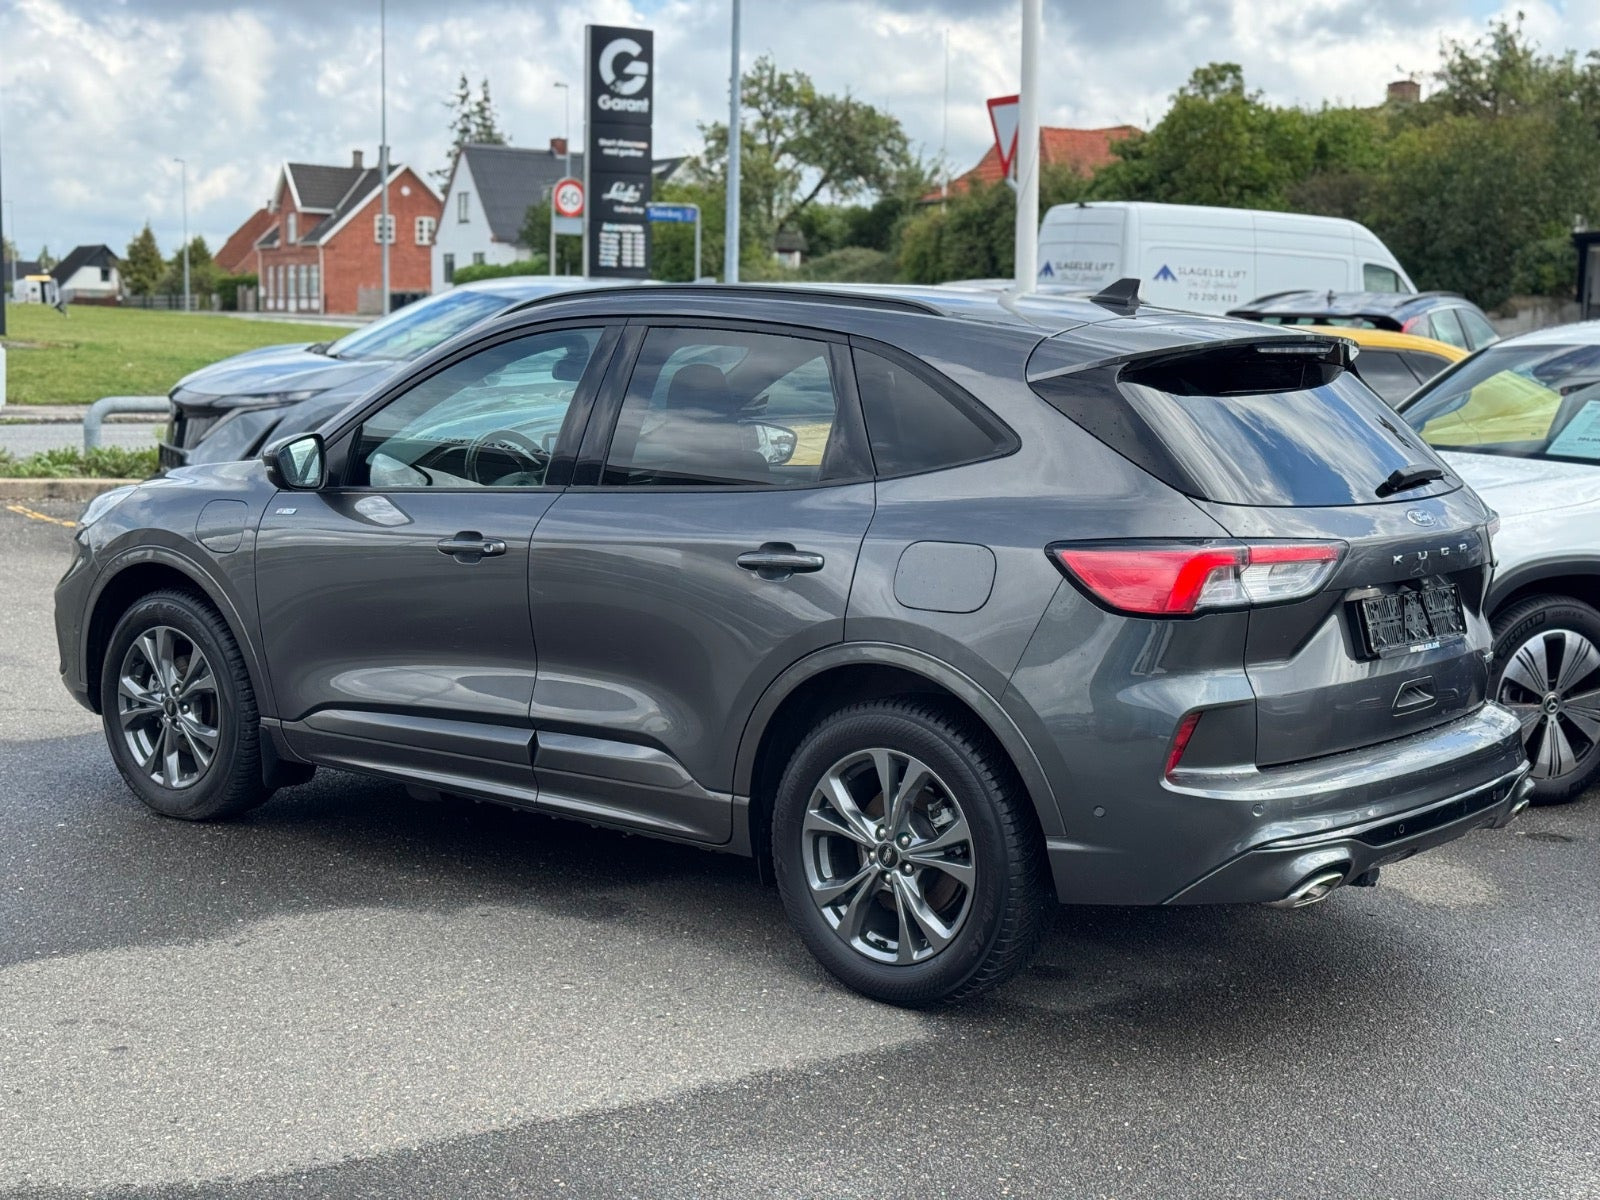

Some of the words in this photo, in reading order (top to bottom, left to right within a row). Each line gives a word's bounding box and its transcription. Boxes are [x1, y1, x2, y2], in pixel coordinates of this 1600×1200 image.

[598, 94, 649, 113] Garant
[561, 190, 580, 206] 60
[1178, 267, 1224, 279] SLAGELSE
[1228, 269, 1247, 280] LIFT
